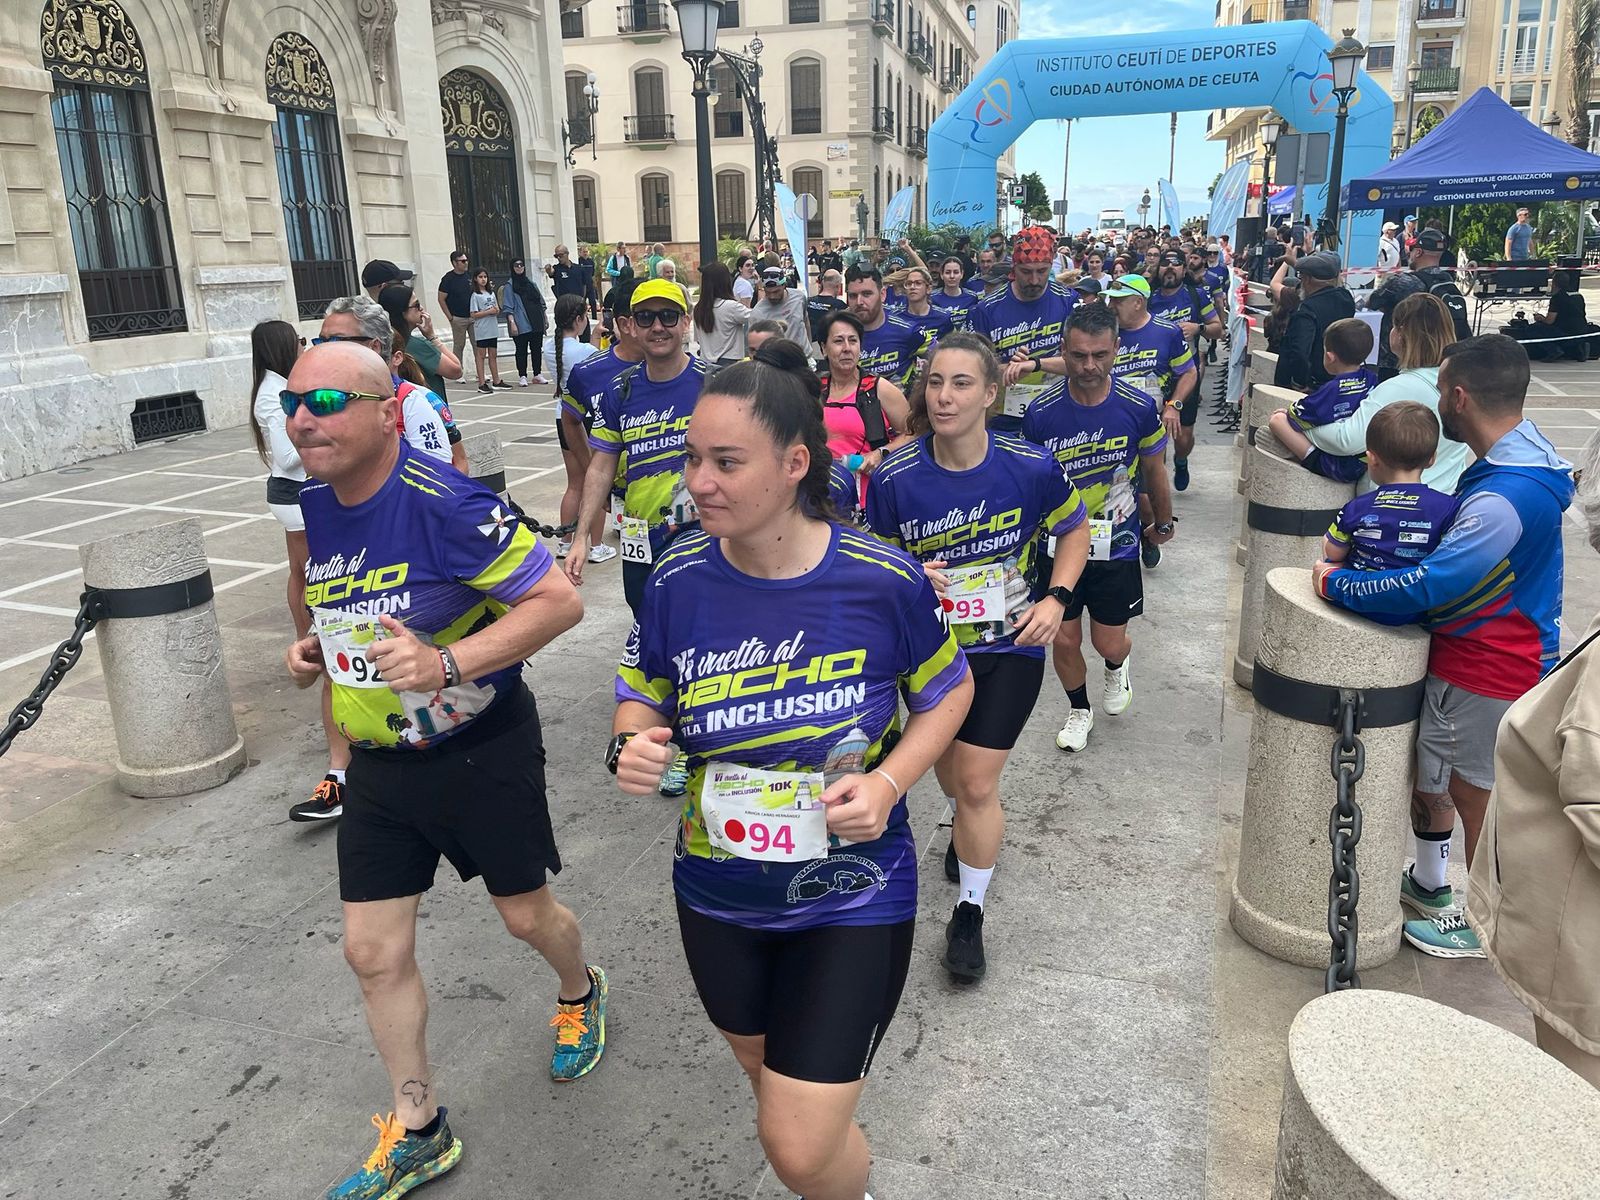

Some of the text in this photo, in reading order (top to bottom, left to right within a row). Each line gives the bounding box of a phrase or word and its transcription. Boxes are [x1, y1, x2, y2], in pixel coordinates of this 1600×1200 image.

[1036, 41, 1277, 73] INSTITUTO CEUTÍ DE DEPORTES
[1050, 71, 1260, 96] CIUDAD AUTÓNOMA DE CEUTA
[1438, 172, 1553, 186] CRONOMETRAJE ORGANIZACIÓN
[1013, 186, 1023, 197] P
[1433, 192, 1465, 201] GESTIÓN
[1475, 190, 1509, 198] EVENTOS
[1509, 188, 1555, 197] DEPORTIVOS
[1008, 334, 1061, 356] INLUSIÓN
[1110, 359, 1158, 374] NCLUSIÓN
[419, 421, 436, 435] AN
[424, 440, 442, 450] RA
[631, 431, 689, 455] INCLUSIÓ
[1065, 450, 1128, 472] INCLUSIÓN
[922, 507, 967, 538] vuelta
[968, 500, 987, 521] al
[621, 541, 645, 560] 126
[933, 529, 1022, 563] INCLUSIÓN
[346, 547, 367, 575] al
[968, 570, 984, 581] 10K
[956, 598, 986, 619] 93
[355, 622, 370, 632] 10K
[698, 636, 771, 677] vuelta
[773, 630, 805, 663] al
[706, 681, 867, 733] INCLUSIÓN
[731, 787, 762, 796] INCLUSIÓN
[768, 780, 792, 793] 10K
[748, 822, 796, 855] 94
